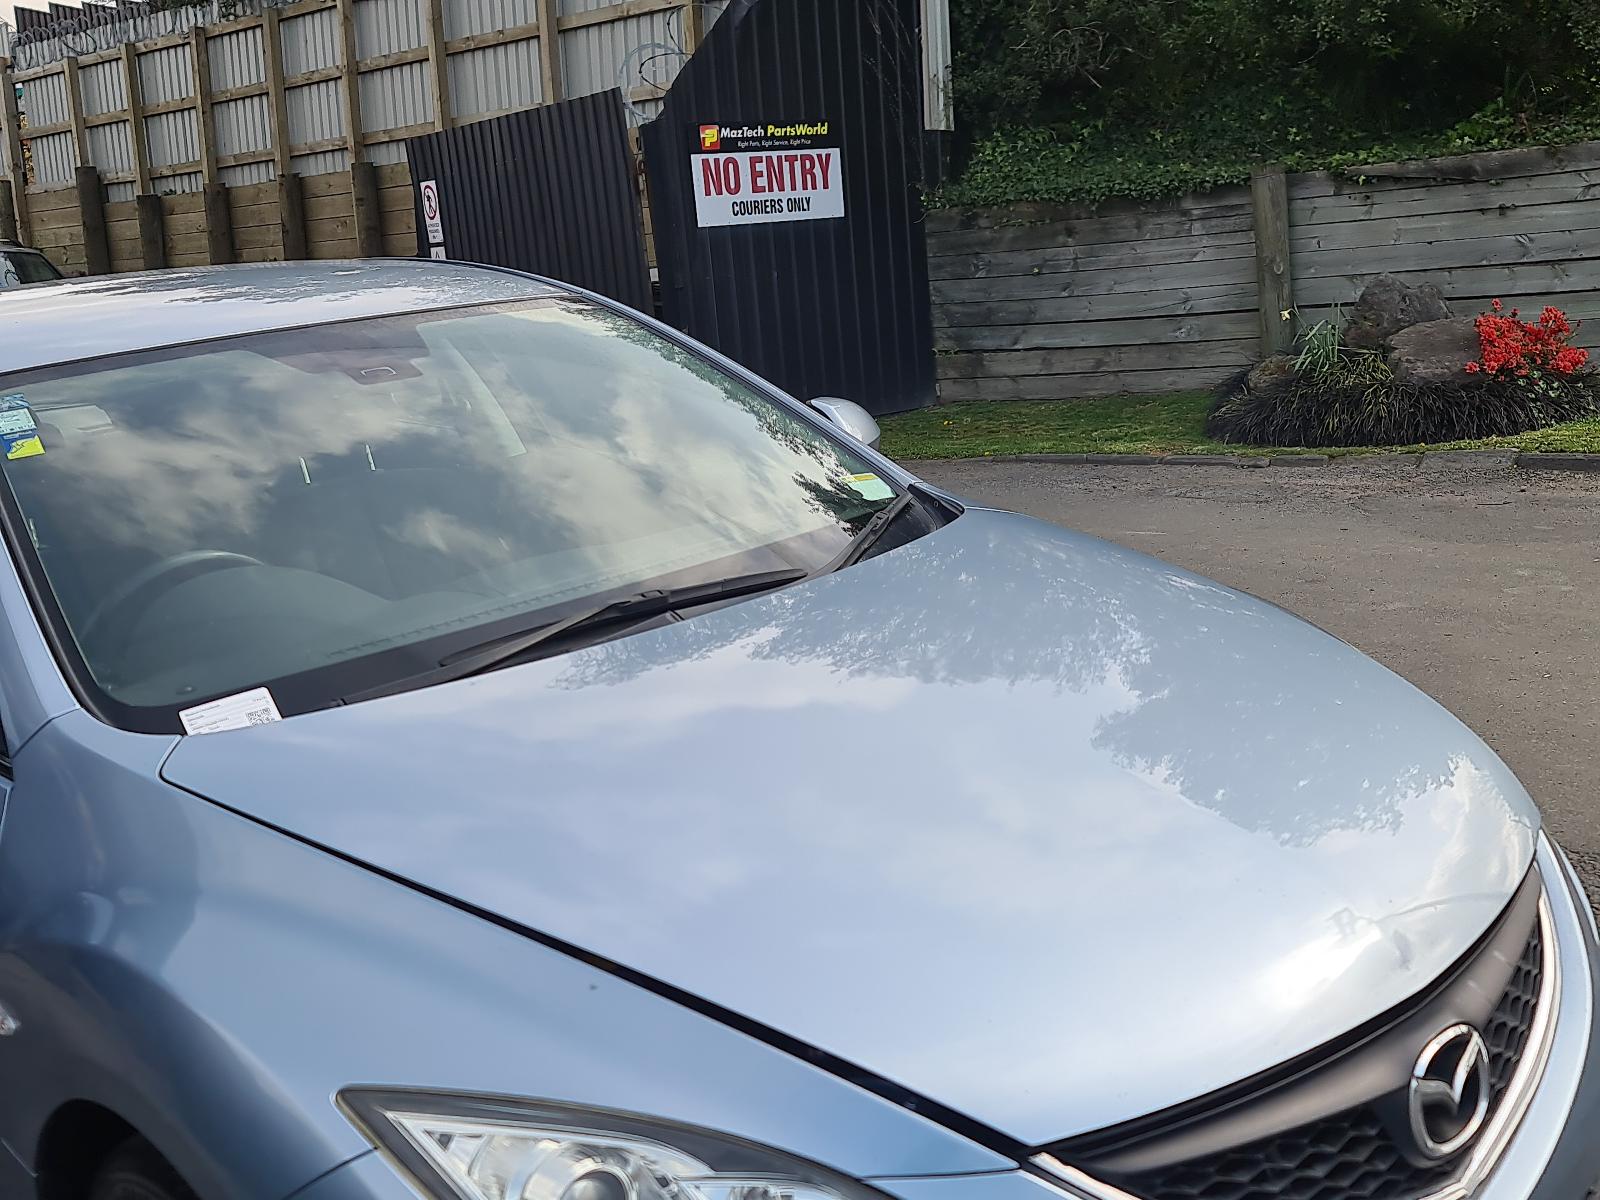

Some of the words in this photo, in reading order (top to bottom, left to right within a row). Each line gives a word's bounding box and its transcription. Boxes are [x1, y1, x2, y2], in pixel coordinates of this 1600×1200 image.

[721, 125, 764, 138] MazTech
[767, 122, 828, 137] PartsWorld
[702, 157, 741, 197] NO
[749, 153, 831, 194] ENTRY
[732, 199, 784, 217] COURIERS
[787, 197, 811, 213] ONLY
